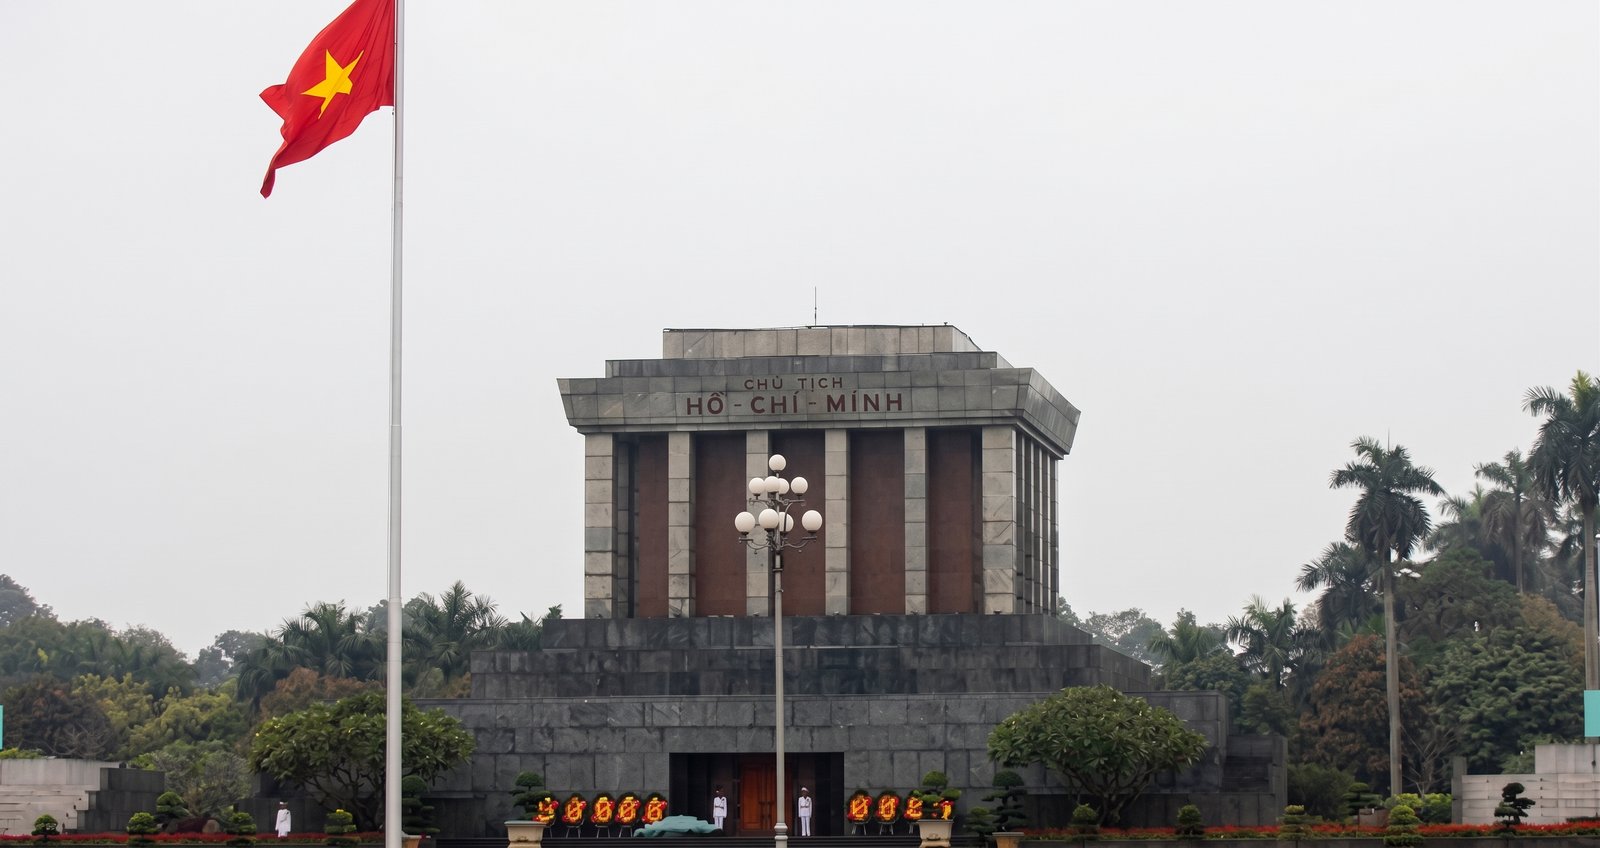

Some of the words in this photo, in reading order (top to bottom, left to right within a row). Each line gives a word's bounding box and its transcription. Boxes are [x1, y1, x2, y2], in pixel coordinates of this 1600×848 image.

[744, 375, 783, 390] CHỦ
[797, 376, 843, 392] TỊCH
[750, 390, 799, 414] CHÍ
[826, 390, 902, 412] MÍNH
